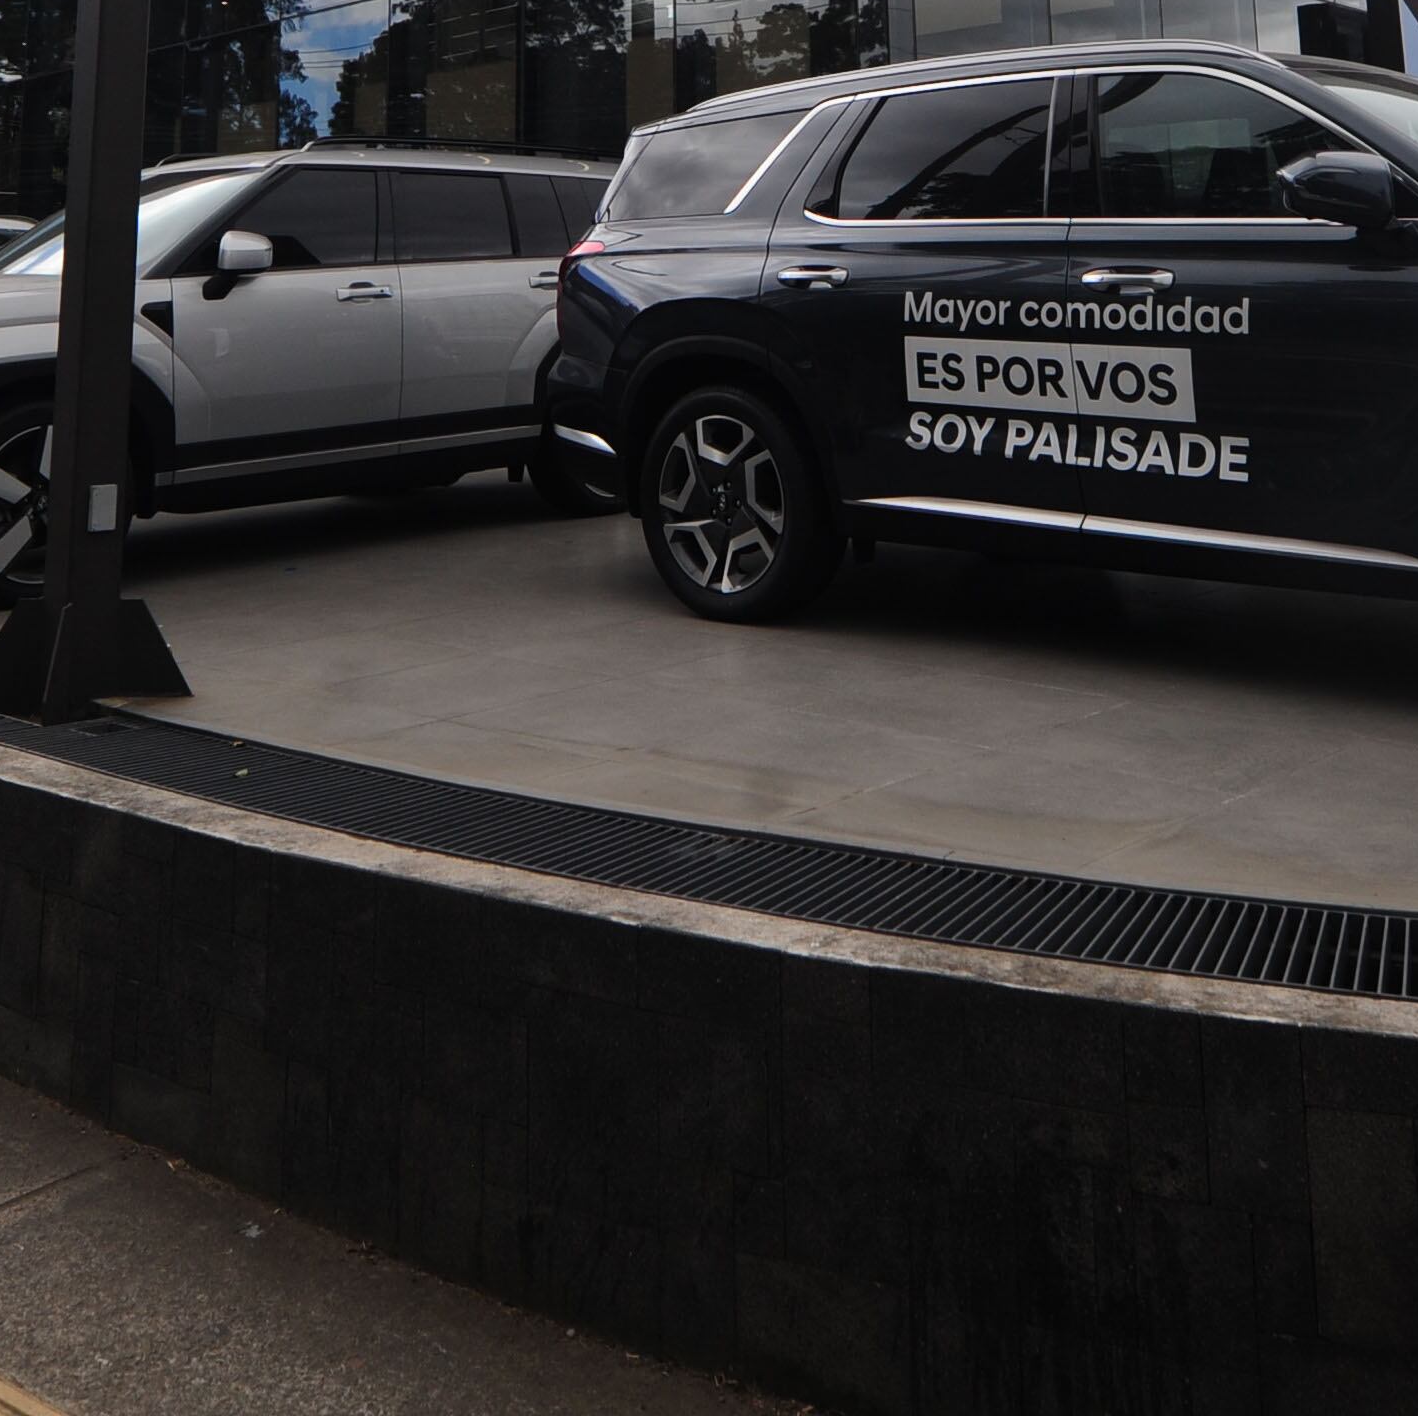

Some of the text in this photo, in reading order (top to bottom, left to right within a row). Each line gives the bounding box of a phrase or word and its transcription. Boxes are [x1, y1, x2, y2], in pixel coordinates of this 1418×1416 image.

[903, 291, 1011, 331] Mayor
[915, 351, 1178, 406] ES POR VOS
[904, 411, 1250, 483] SOY PALISADE
